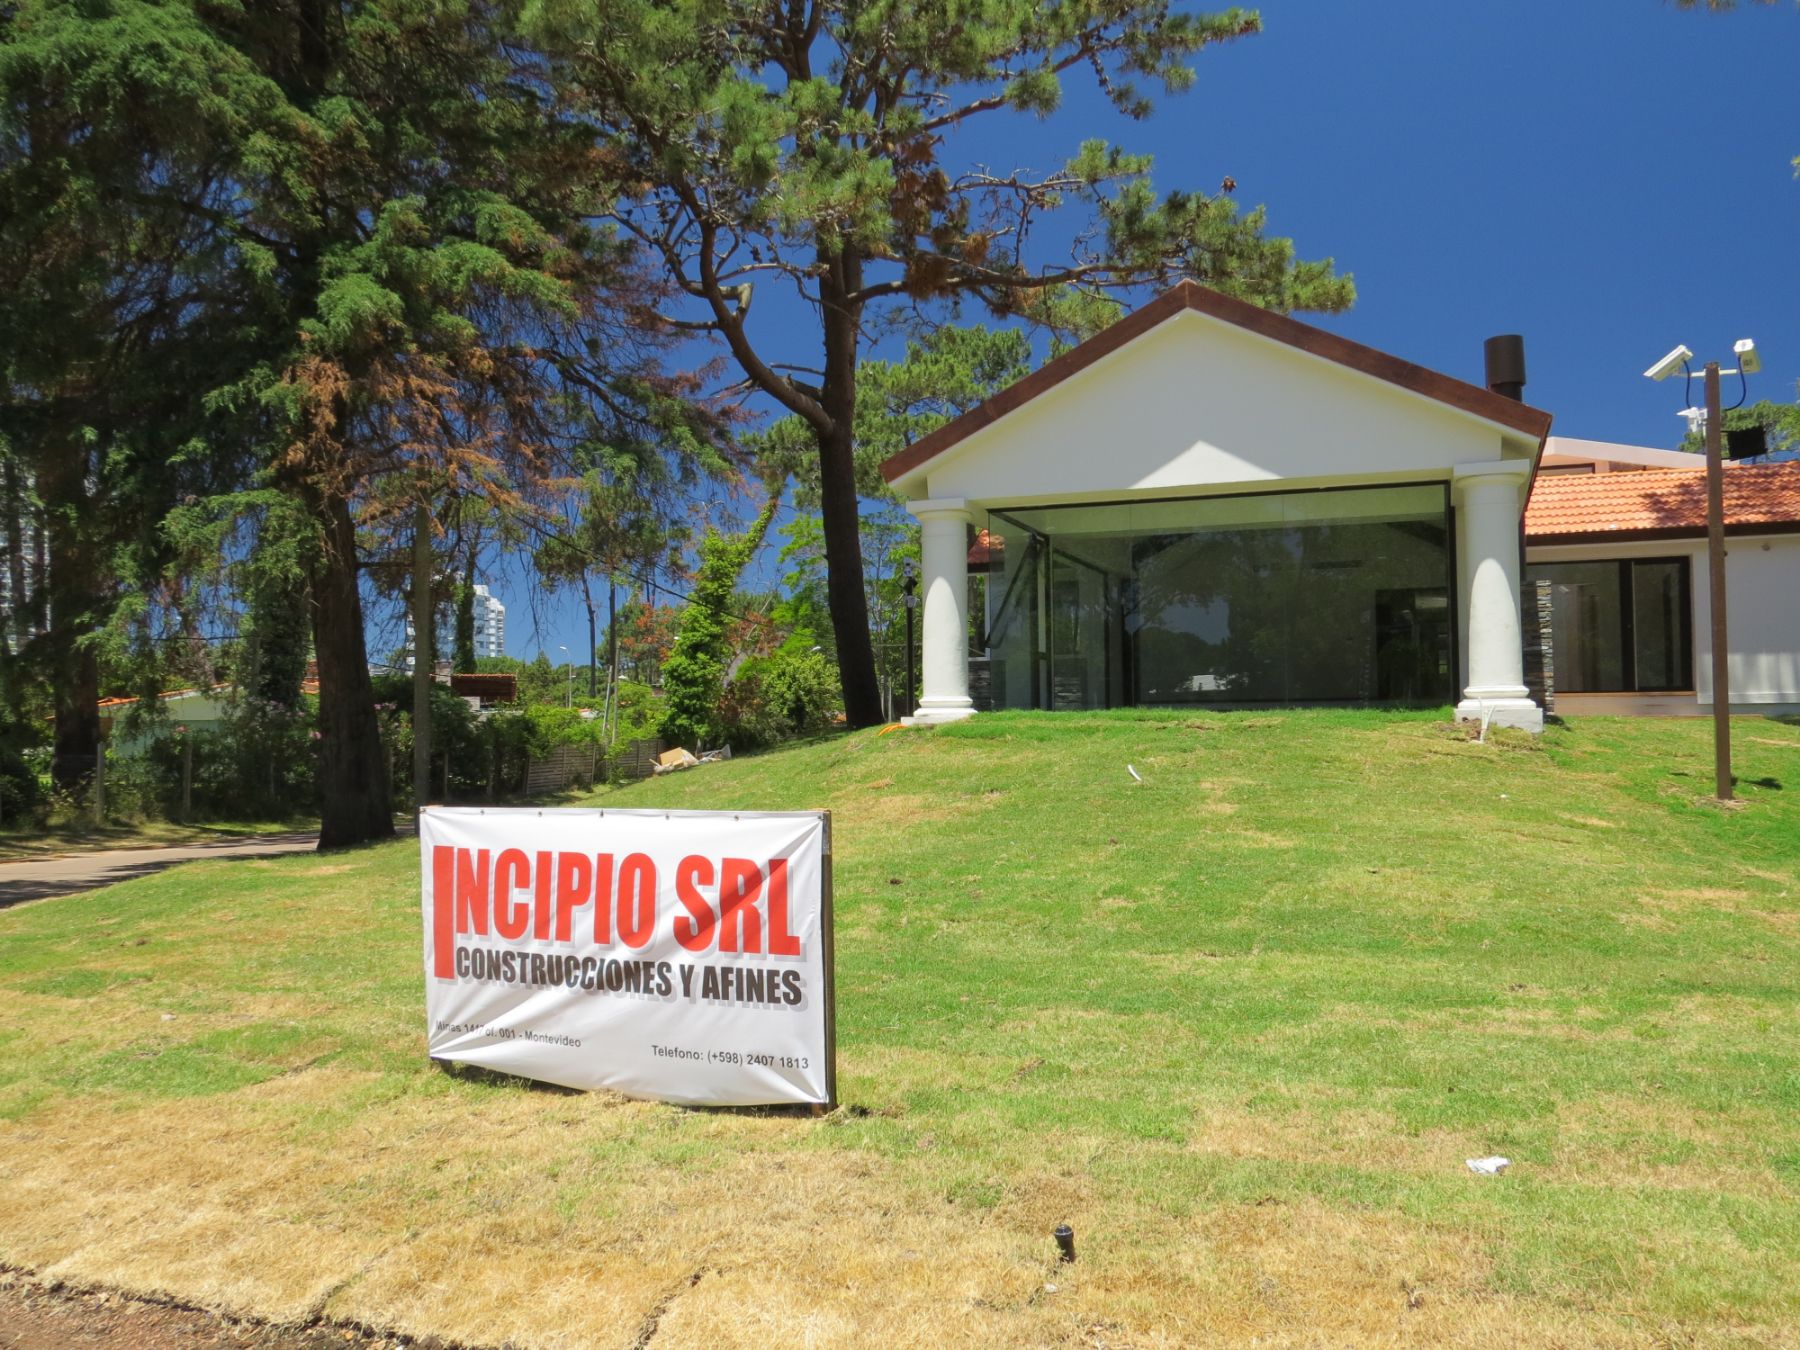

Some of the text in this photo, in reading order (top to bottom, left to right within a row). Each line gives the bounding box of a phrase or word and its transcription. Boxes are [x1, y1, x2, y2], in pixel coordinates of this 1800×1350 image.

[433, 845, 801, 979] INCIPIO SRL
[456, 946, 802, 1006] CONSTRUCCIONES Y AFINES
[499, 1029, 516, 1039] 001
[525, 1030, 582, 1048] Montevideo
[652, 1045, 809, 1070] Telefono: (+598) 2407 1813
